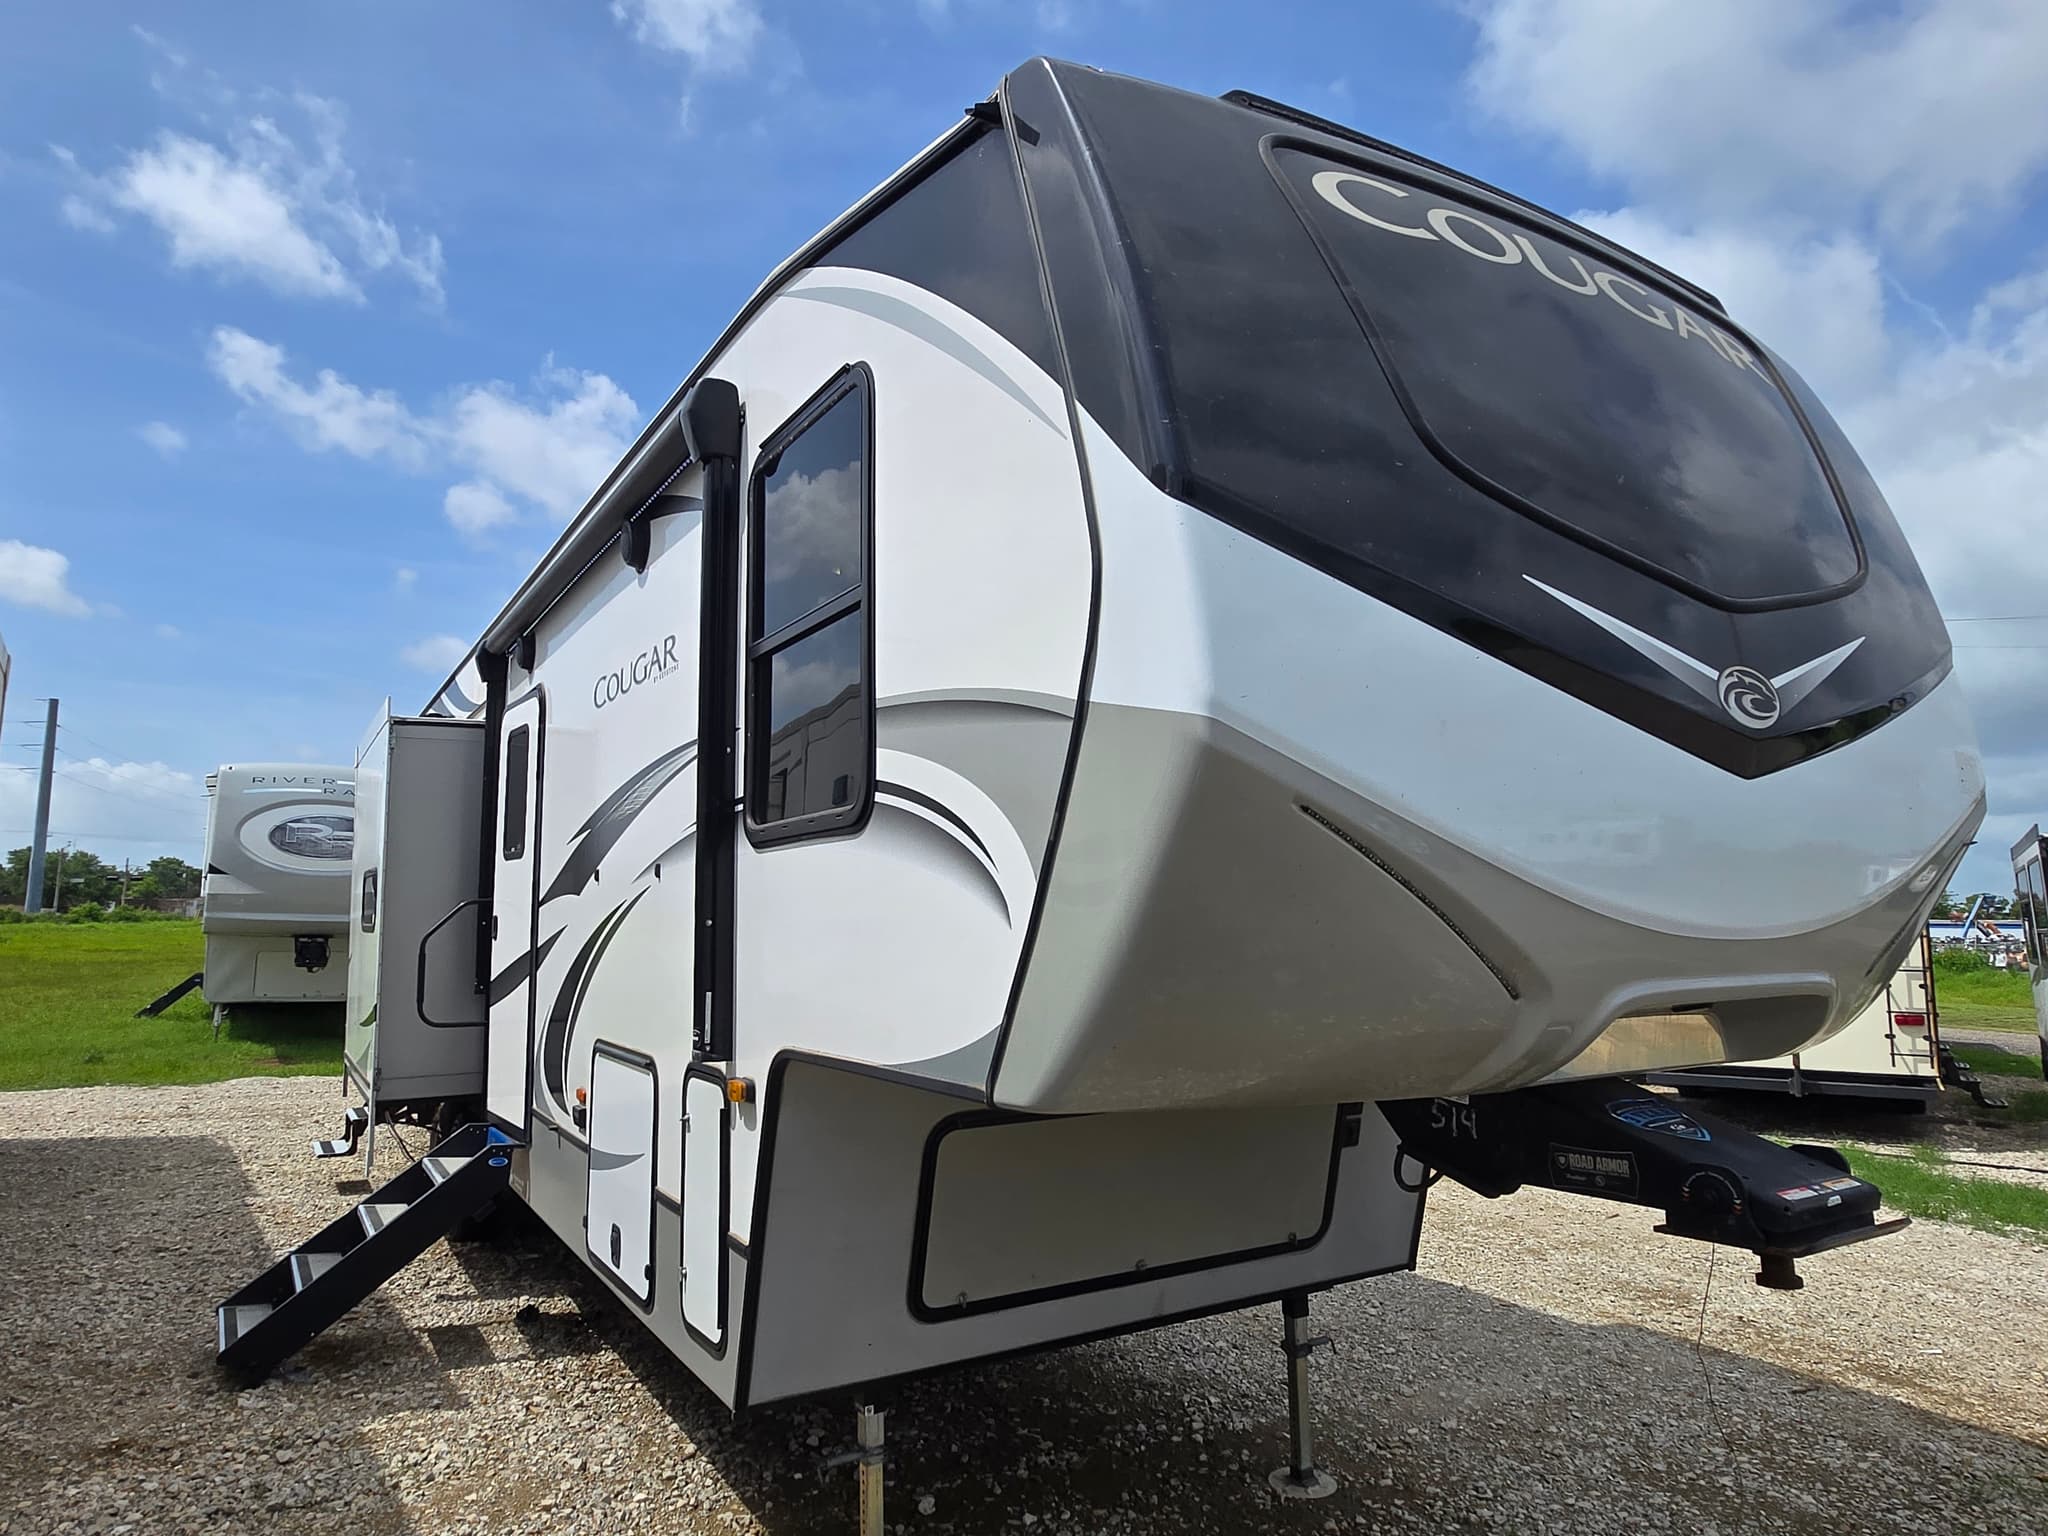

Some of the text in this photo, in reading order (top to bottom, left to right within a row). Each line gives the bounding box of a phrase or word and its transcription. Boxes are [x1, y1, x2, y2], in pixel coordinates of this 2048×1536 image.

[1311, 170, 1775, 388] COUGAR
[593, 634, 679, 709] COUGAR
[252, 776, 336, 785] RIVER
[1569, 1153, 1630, 1175] ROAD ARMOR
